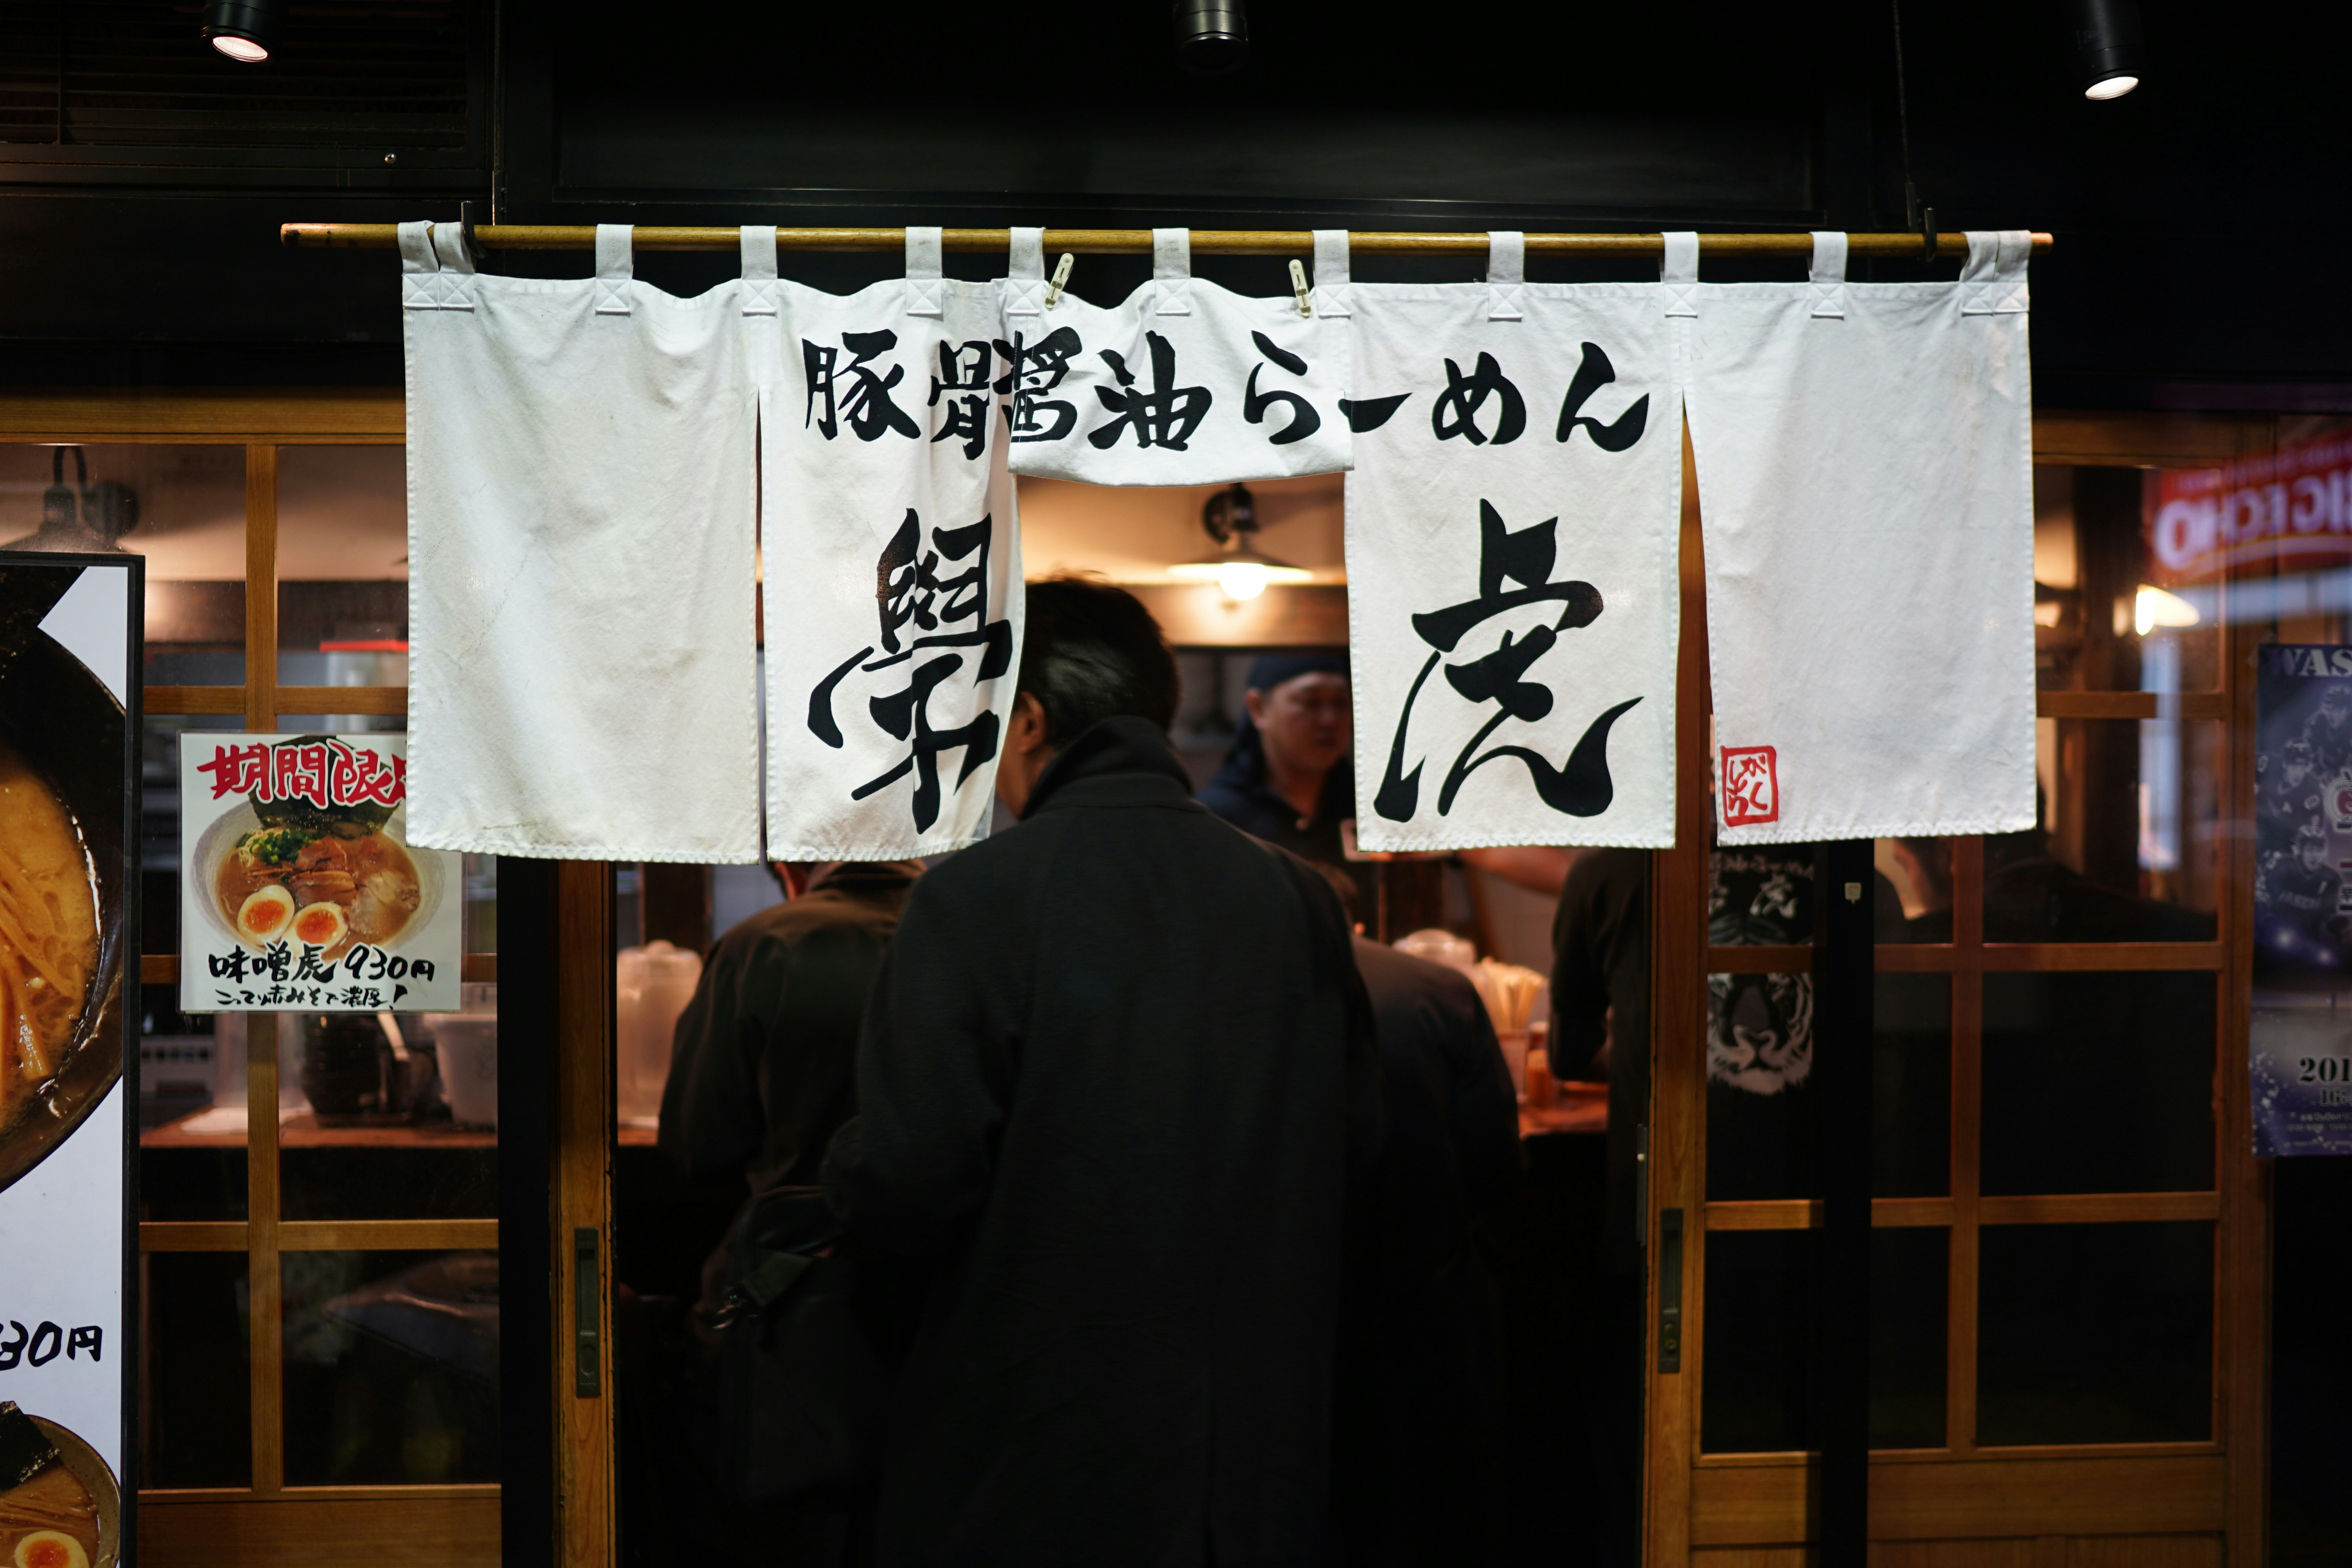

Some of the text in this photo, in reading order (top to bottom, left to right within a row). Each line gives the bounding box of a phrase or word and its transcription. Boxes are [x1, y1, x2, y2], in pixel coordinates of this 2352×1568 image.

[1374, 499, 1643, 822] 虎
[209, 941, 435, 984] 味噌虎 930円
[0, 1320, 103, 1371] 30円
